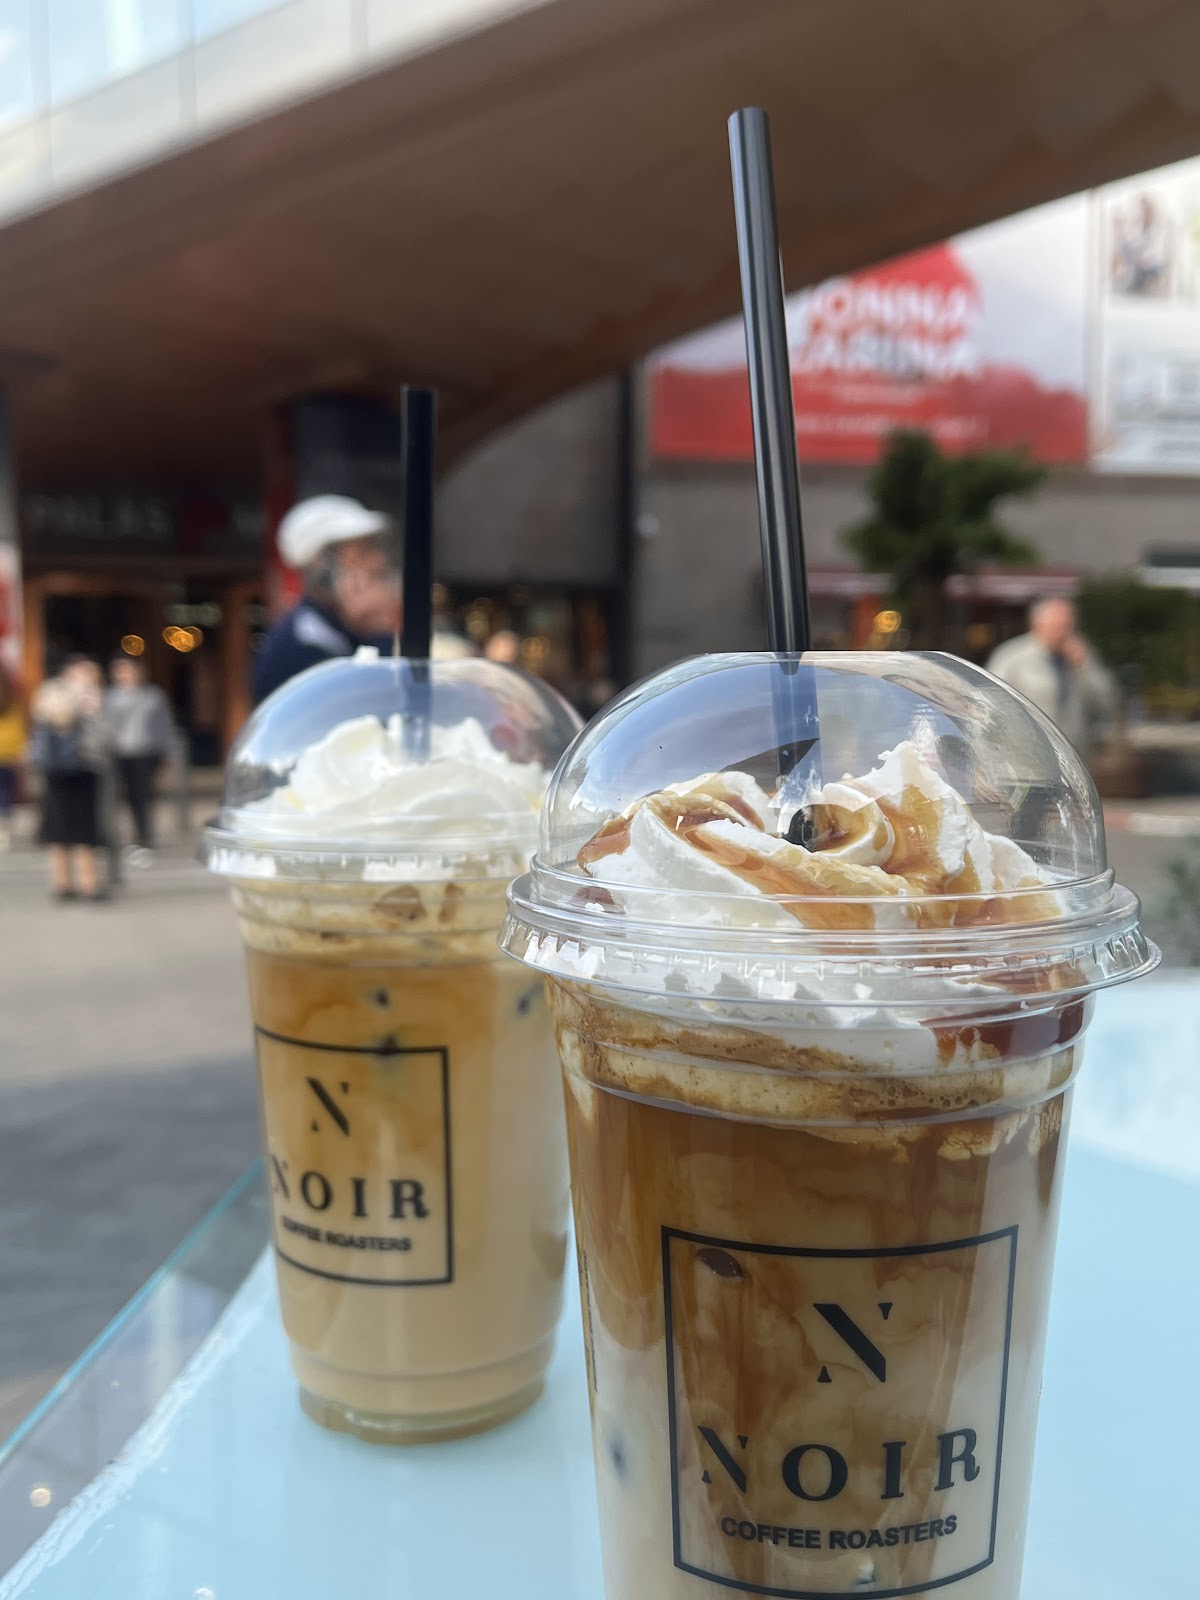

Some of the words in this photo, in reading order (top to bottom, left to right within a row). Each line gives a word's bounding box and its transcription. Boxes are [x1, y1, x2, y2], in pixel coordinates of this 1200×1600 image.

[305, 1076, 350, 1136] N
[272, 1154, 430, 1219] NOIR
[813, 1302, 893, 1383] N
[698, 1425, 980, 1501] NOIR
[720, 1516, 821, 1549] COFFEE
[829, 1514, 957, 1549] ROASTERS
